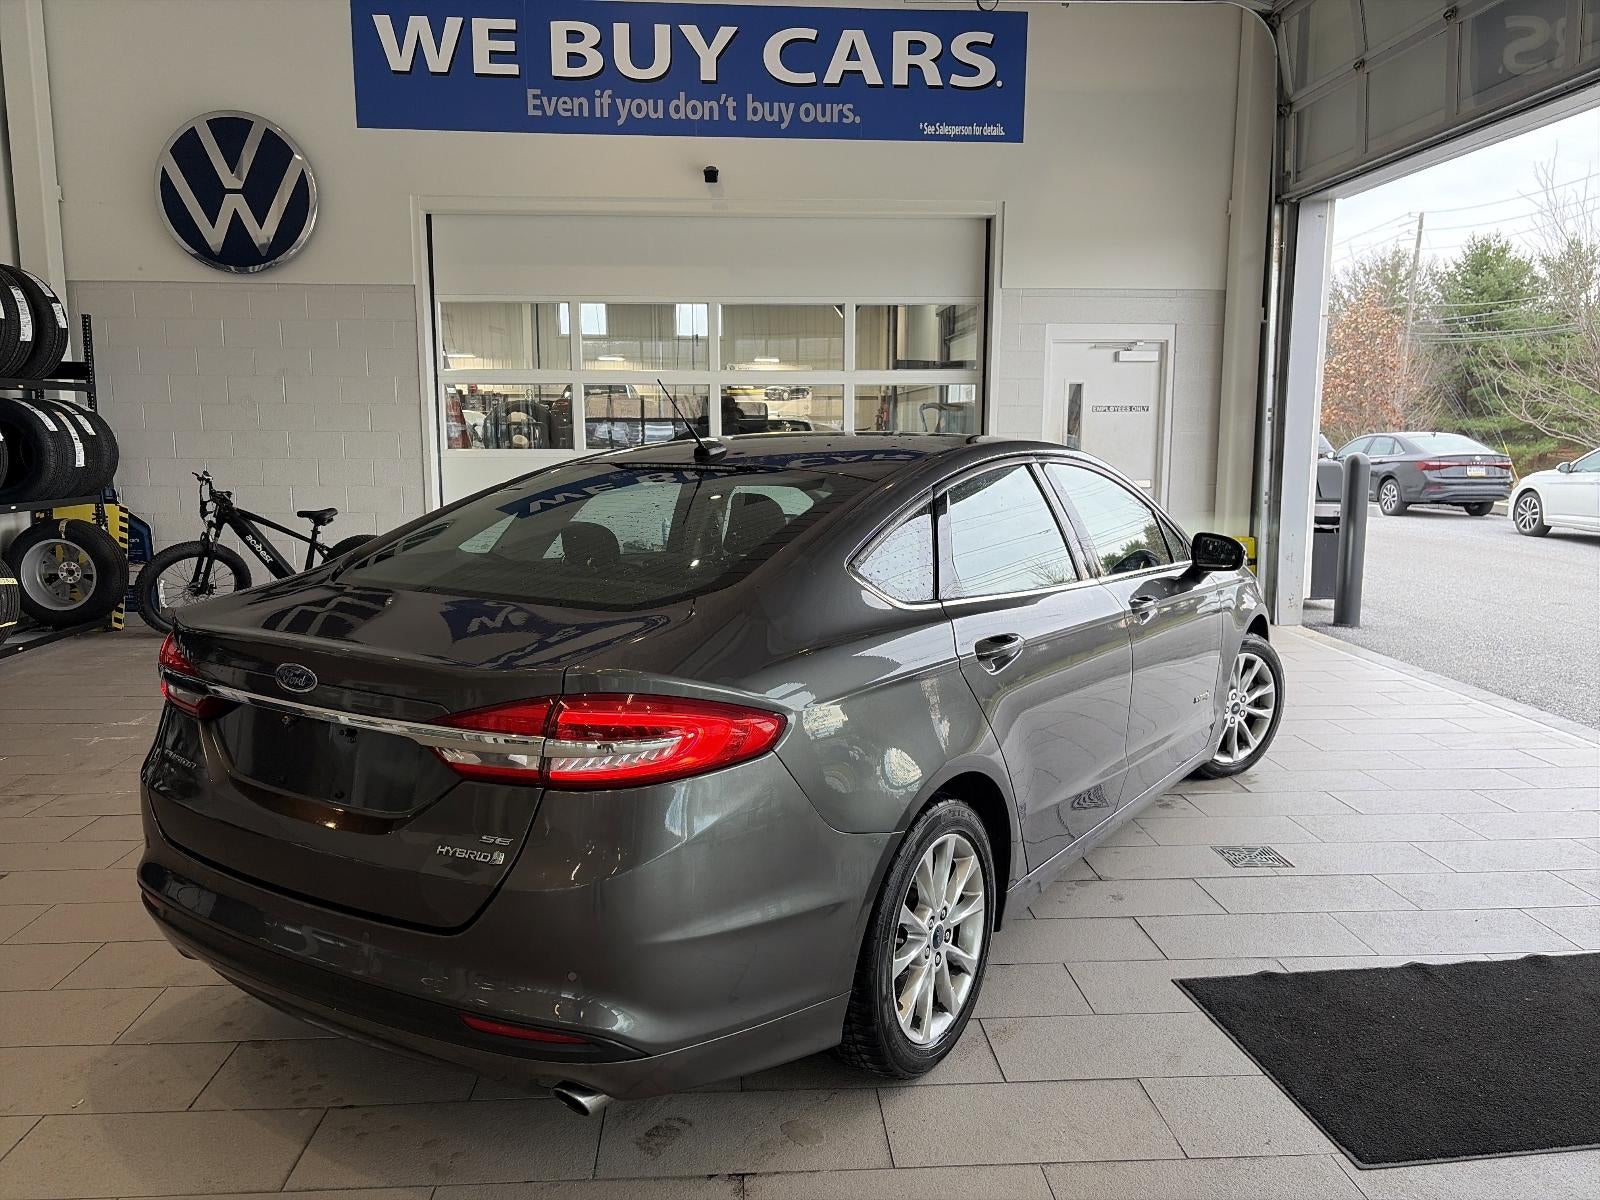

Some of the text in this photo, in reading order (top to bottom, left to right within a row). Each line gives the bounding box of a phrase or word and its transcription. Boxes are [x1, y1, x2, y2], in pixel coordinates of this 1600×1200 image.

[372, 14, 1003, 89] WE BUY CARS.
[527, 88, 861, 130] Even if you don't buy ours.
[936, 122, 972, 138] Salesperson
[973, 123, 982, 135] for
[983, 123, 1005, 136] details.
[1092, 405, 1149, 413] EMPLOYEES ONLY
[478, 834, 514, 846] SE
[436, 845, 491, 863] HYBRID
